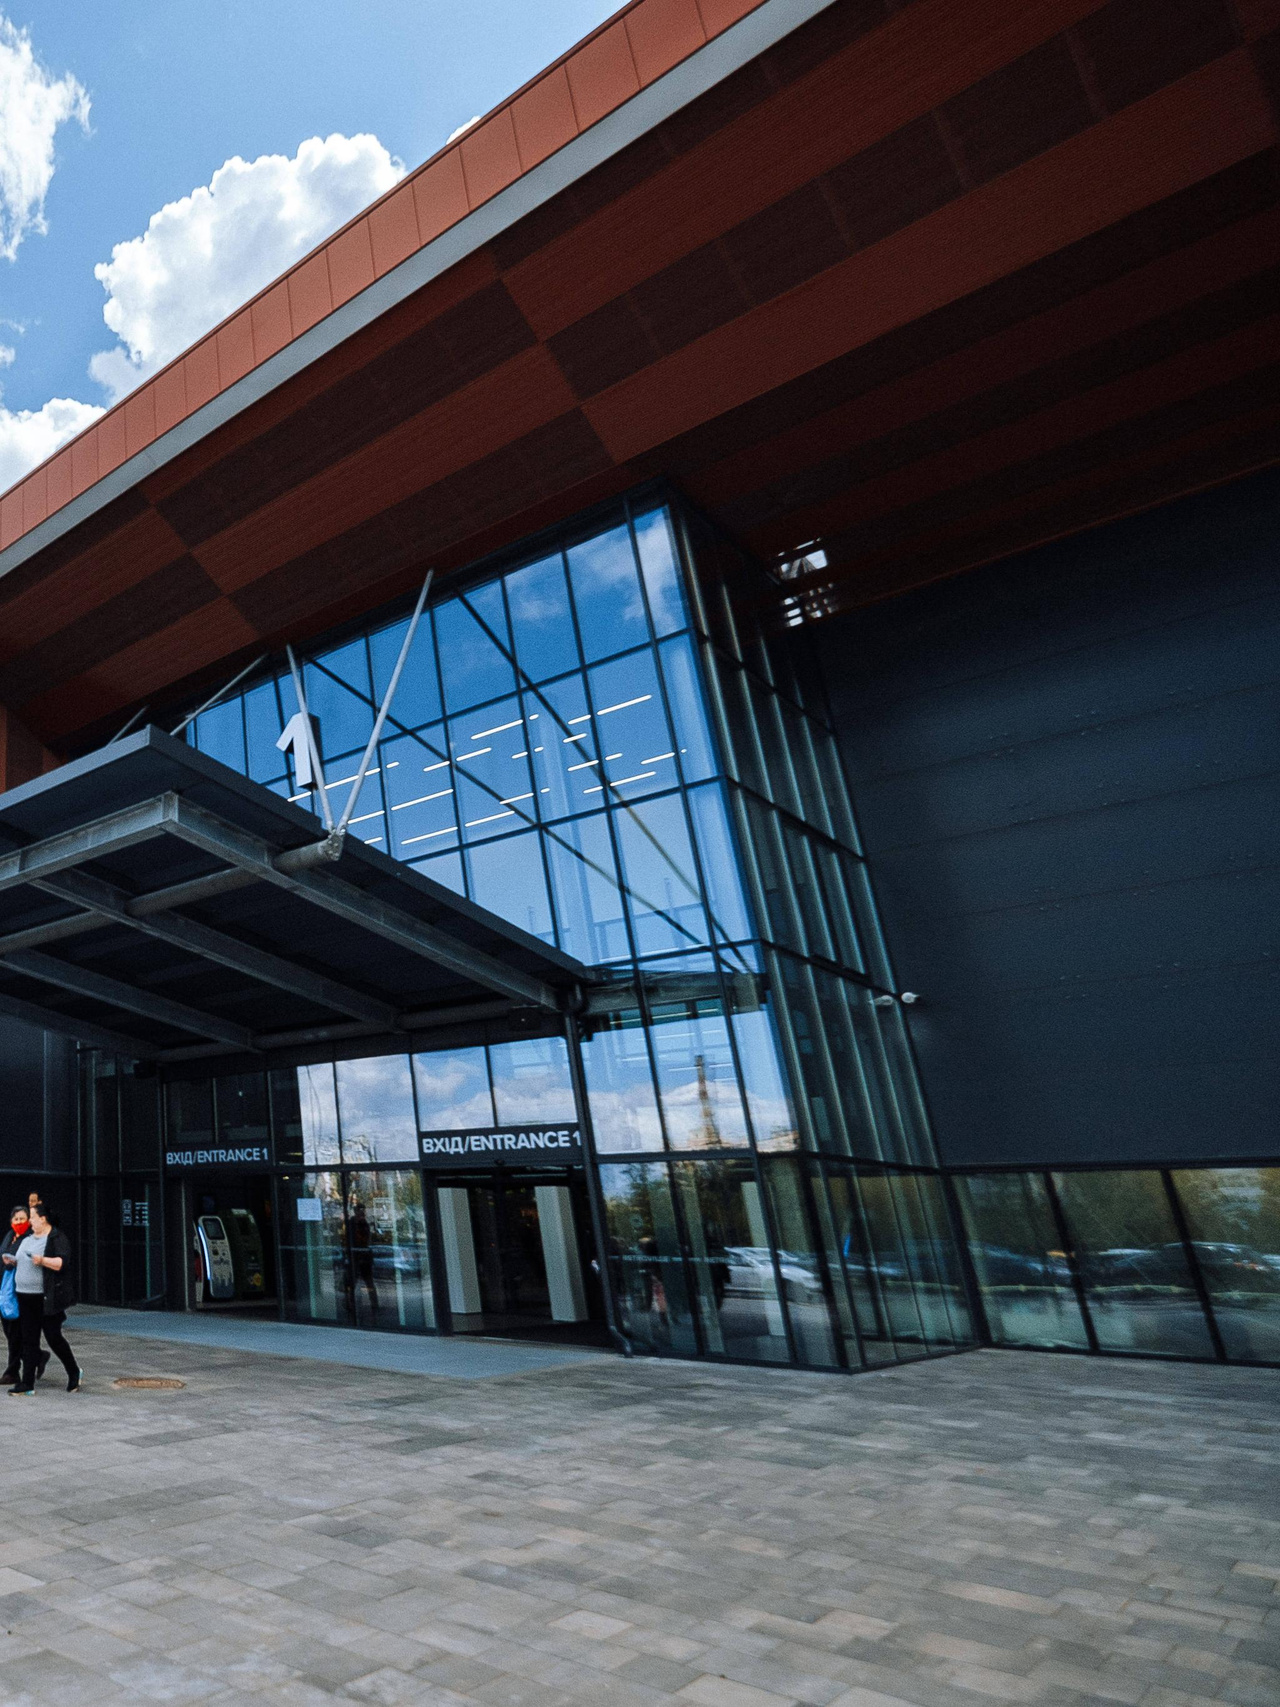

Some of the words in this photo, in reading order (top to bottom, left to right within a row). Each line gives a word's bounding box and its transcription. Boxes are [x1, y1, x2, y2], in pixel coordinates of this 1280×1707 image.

[275, 711, 313, 786] 1
[422, 1131, 570, 1155] ВХІД/ENTRANCE
[572, 1130, 582, 1147] 1
[166, 1147, 261, 1166] ВХІД/ENTRANCE
[262, 1147, 269, 1160] 1
